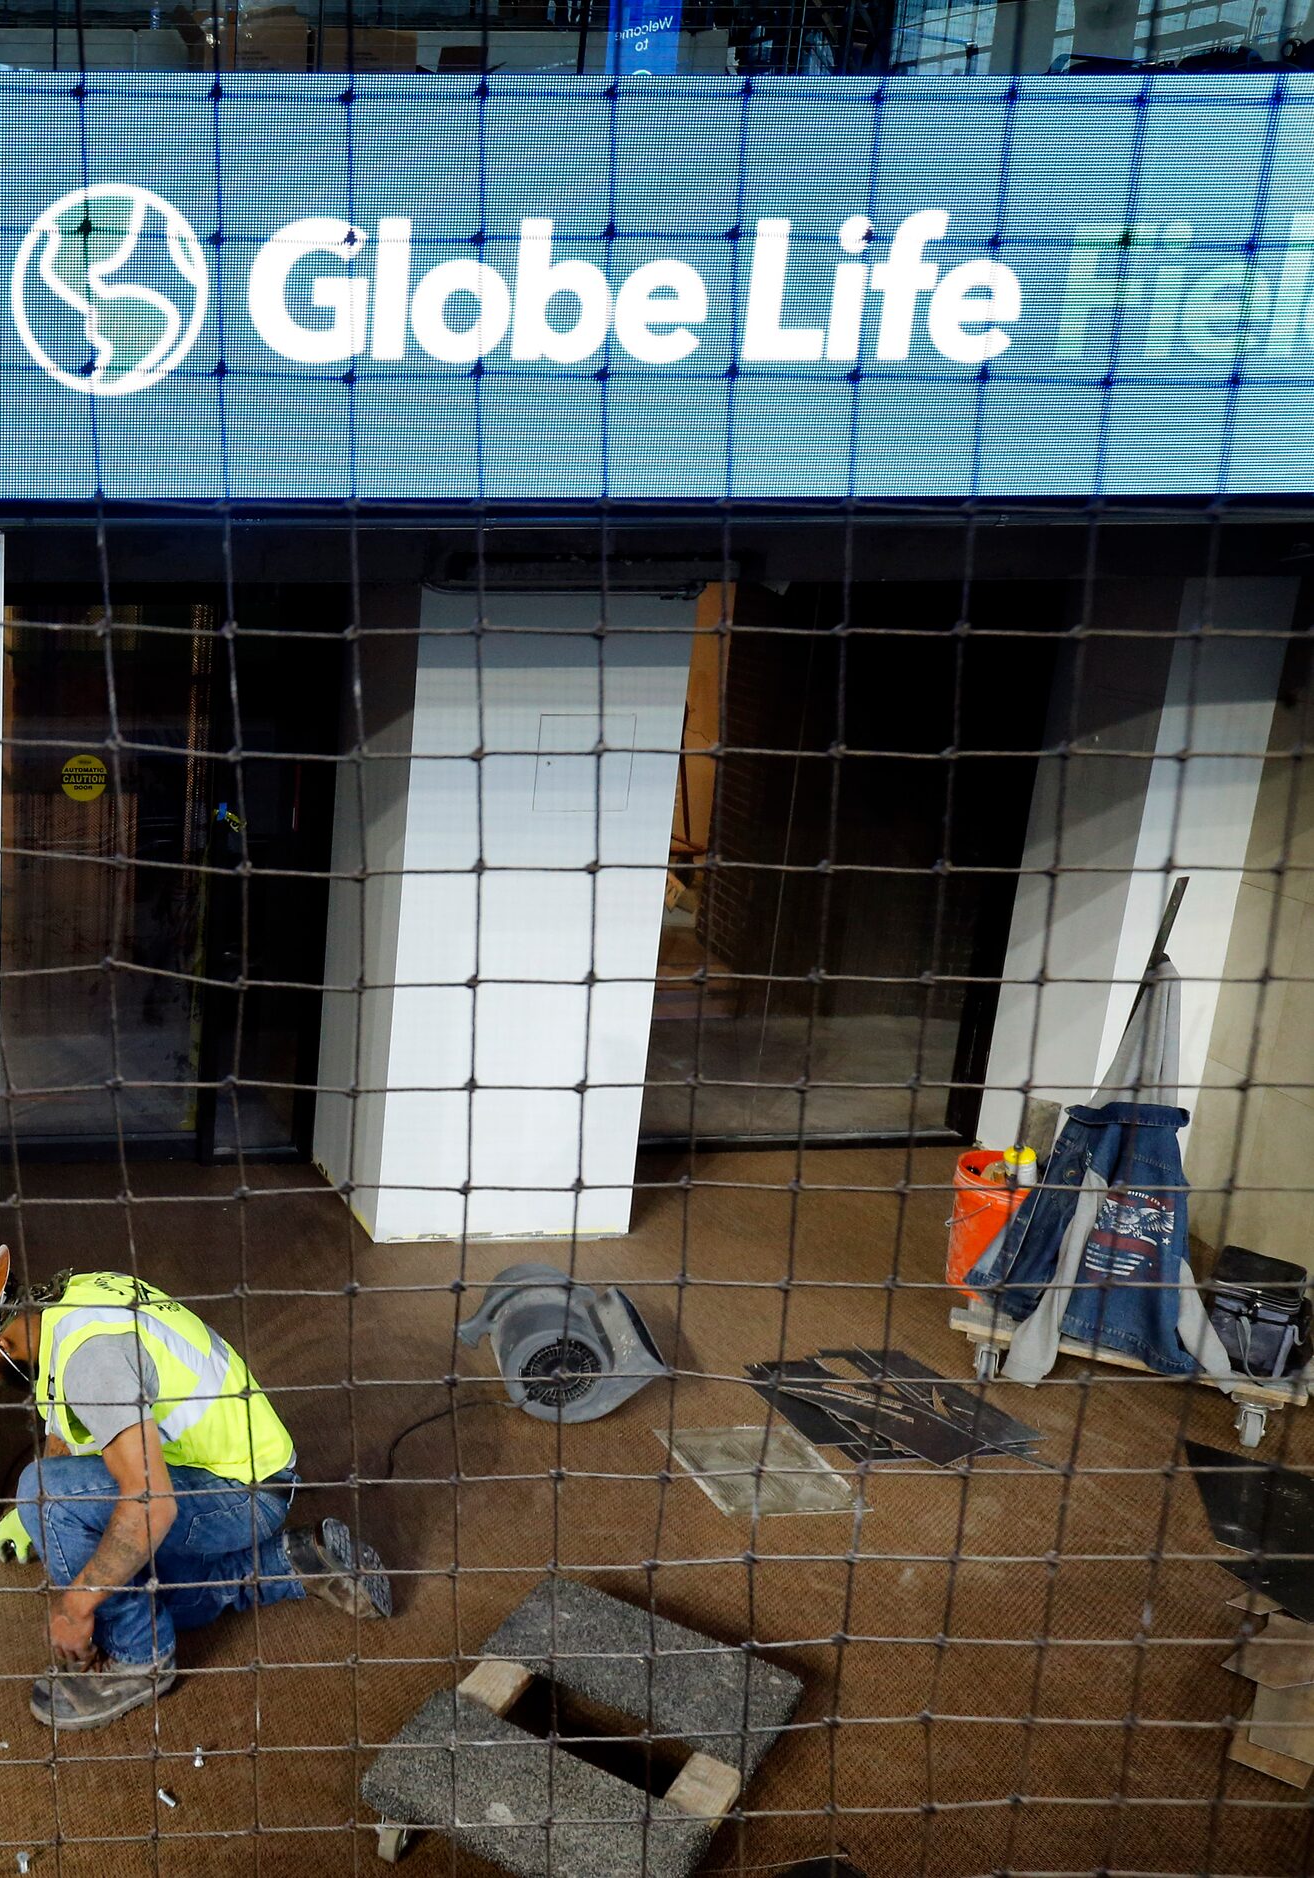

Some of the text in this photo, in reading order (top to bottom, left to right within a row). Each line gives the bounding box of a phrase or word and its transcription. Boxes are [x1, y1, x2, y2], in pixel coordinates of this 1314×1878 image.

[248, 217, 706, 362] Globe
[743, 211, 1020, 362] Life
[1052, 213, 1314, 360] Fiel
[62, 775, 105, 783] CAUTION
